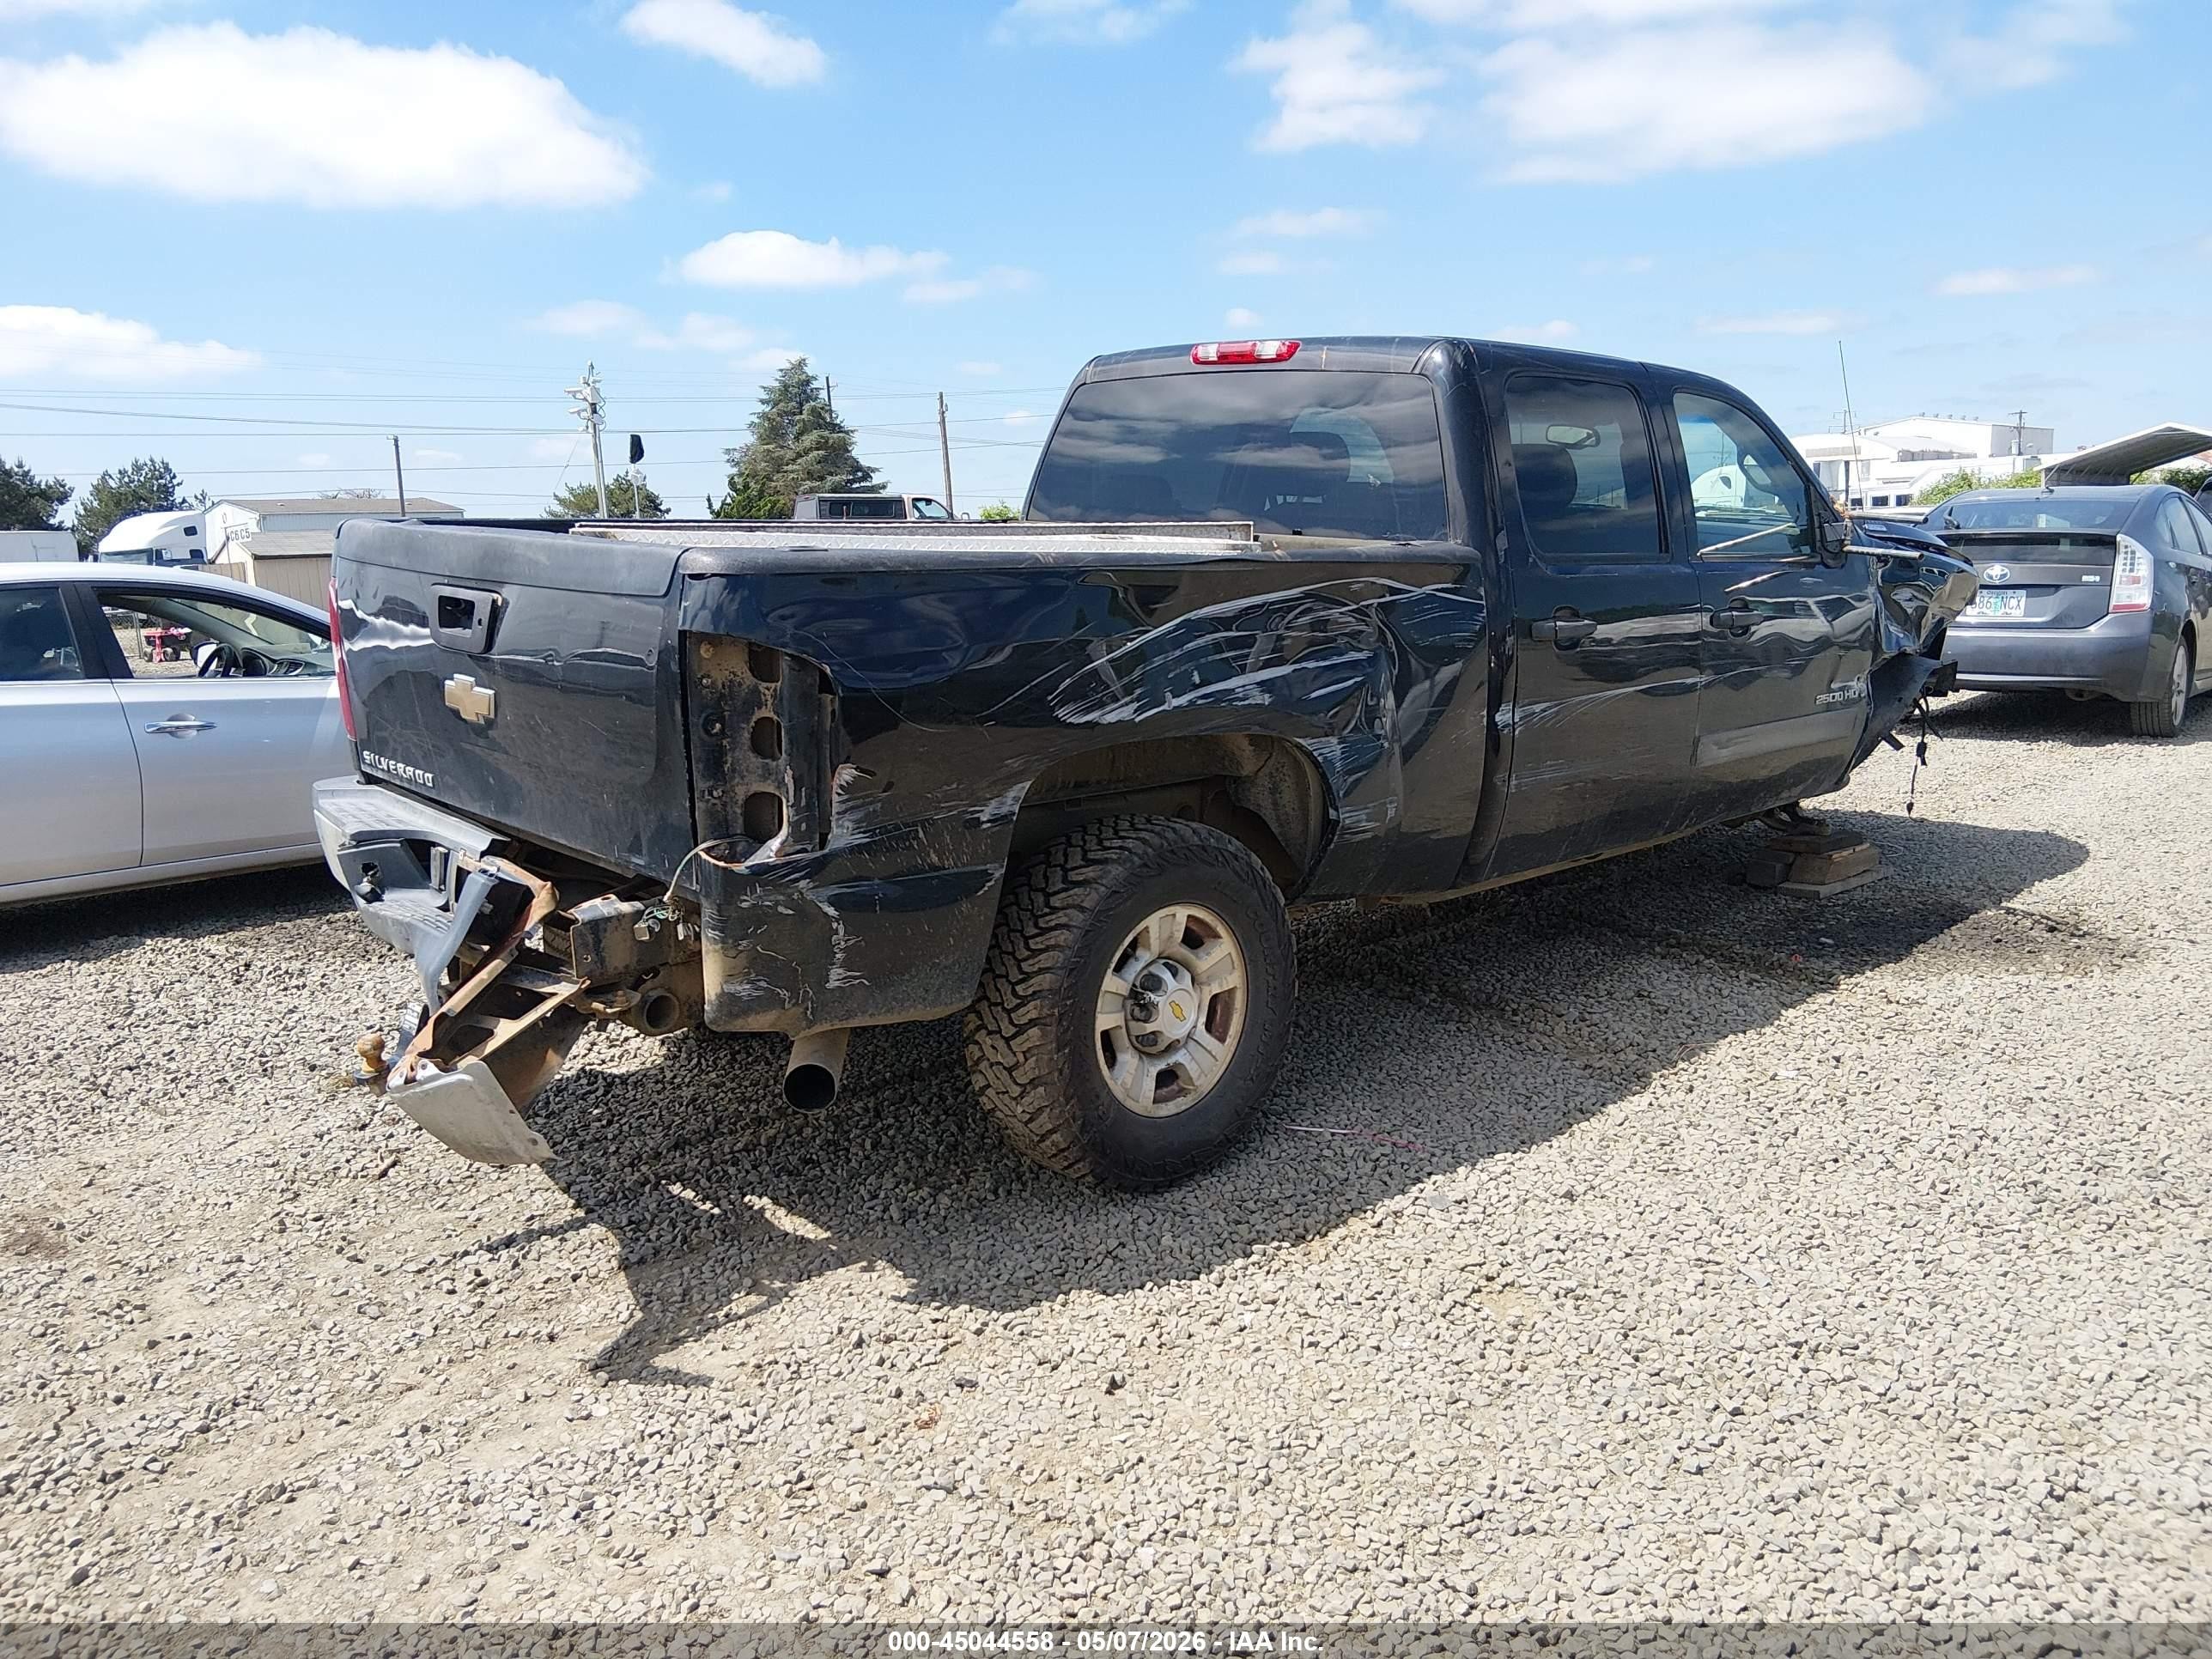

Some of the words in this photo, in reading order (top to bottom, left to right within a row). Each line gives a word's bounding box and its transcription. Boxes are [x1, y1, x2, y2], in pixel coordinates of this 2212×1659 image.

[1999, 595, 2022, 611] NCX
[1815, 691, 1844, 705] 2500
[362, 750, 435, 788] SILVERADO
